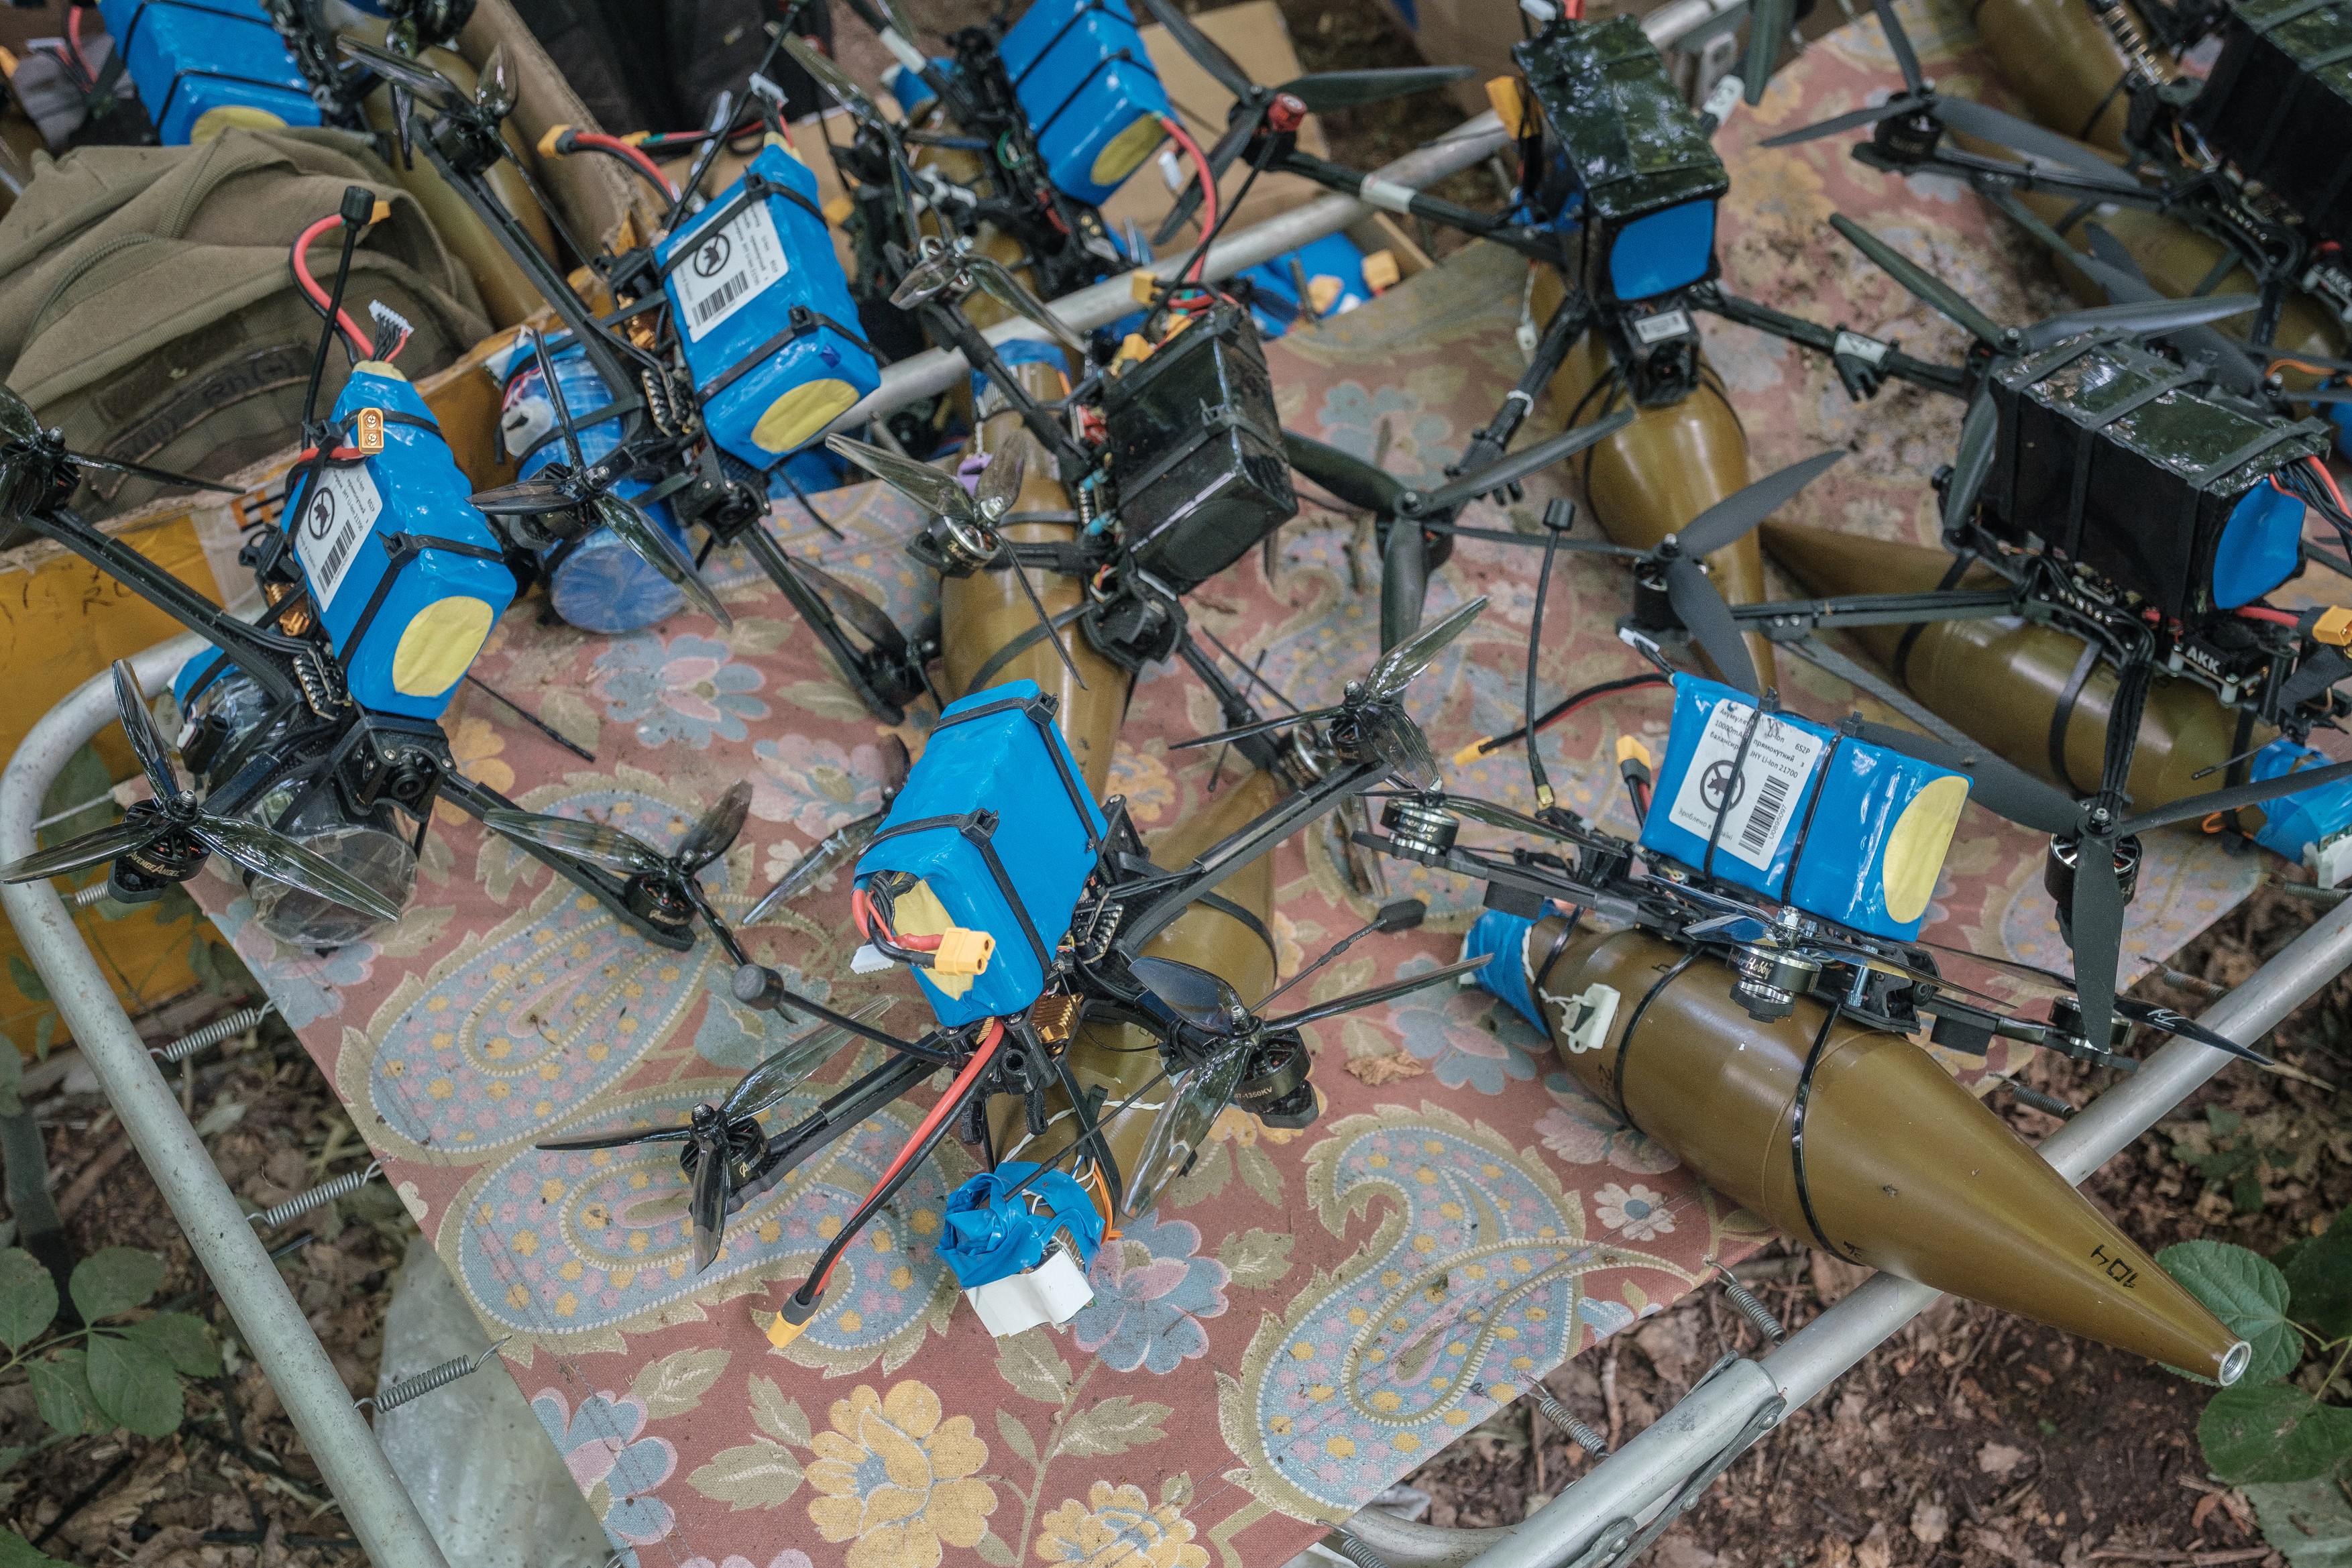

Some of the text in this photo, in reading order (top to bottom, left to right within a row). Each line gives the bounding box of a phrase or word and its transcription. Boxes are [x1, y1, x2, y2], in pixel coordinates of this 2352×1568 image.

[2186, 646, 2221, 675] AKK
[1710, 732, 1798, 779] балансир JHY Li-Ion 21700
[1715, 720, 1744, 738] 10000mA
[1753, 739, 1795, 763] прямокутний
[1795, 743, 1811, 754] 6S2P
[1679, 807, 1707, 828] Зроблено
[2090, 1244, 2140, 1288] 104
